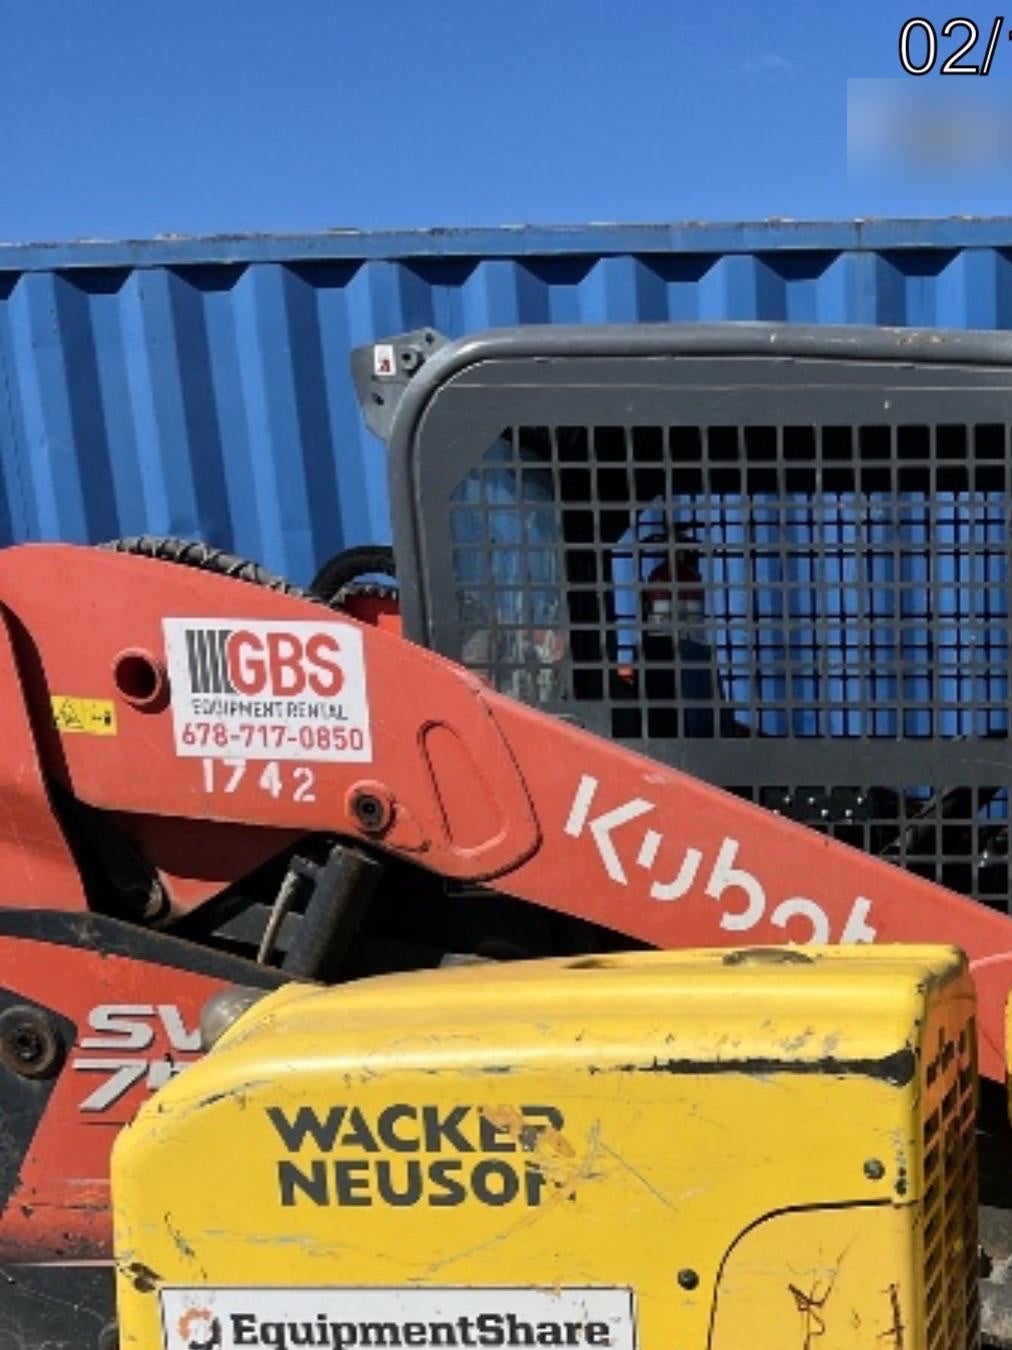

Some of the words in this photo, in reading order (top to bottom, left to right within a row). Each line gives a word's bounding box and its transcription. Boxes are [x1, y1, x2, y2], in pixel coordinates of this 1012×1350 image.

[227, 629, 345, 698] GBS
[182, 722, 364, 751] 678-717-0850
[202, 757, 316, 802] 1742
[564, 773, 877, 946] Kubot
[265, 1103, 566, 1153] WACKER
